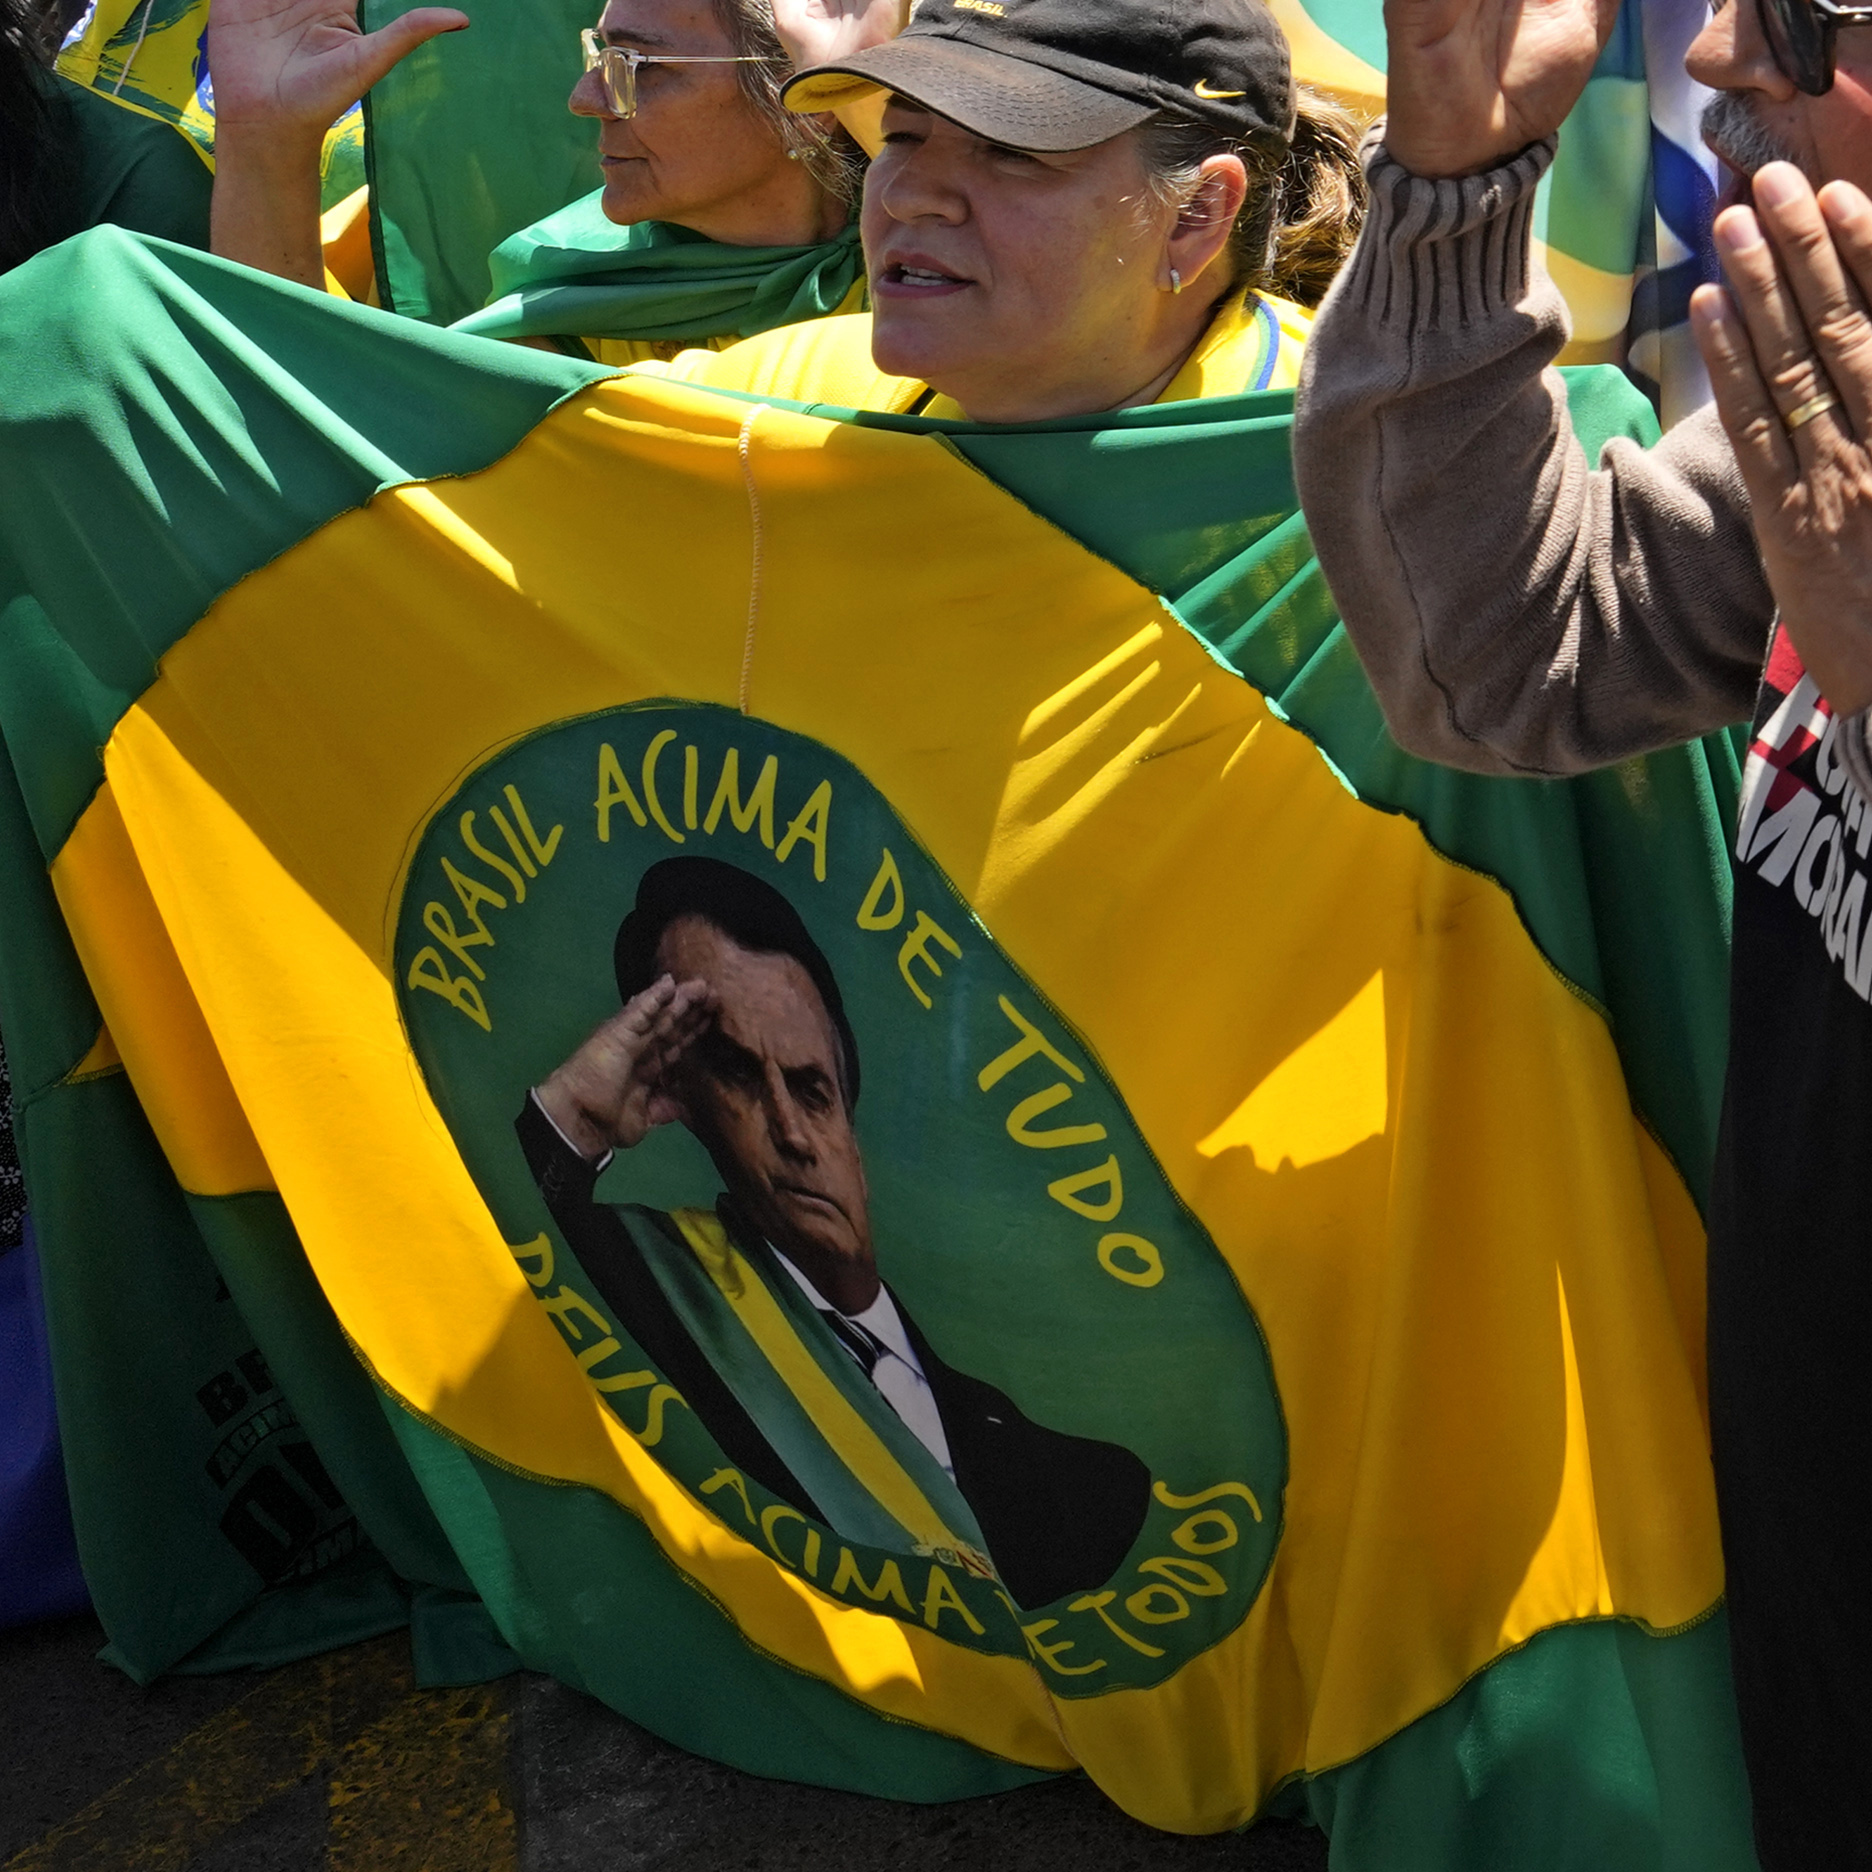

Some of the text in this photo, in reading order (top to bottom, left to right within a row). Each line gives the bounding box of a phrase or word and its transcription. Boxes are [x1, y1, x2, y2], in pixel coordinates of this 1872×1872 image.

[407, 728, 1166, 1289] BRASIL ACIMA DE TUDO
[508, 1229, 691, 1448] DEUS
[699, 1465, 986, 1637] ACIMA
[1067, 1478, 1264, 1659] TODOS
